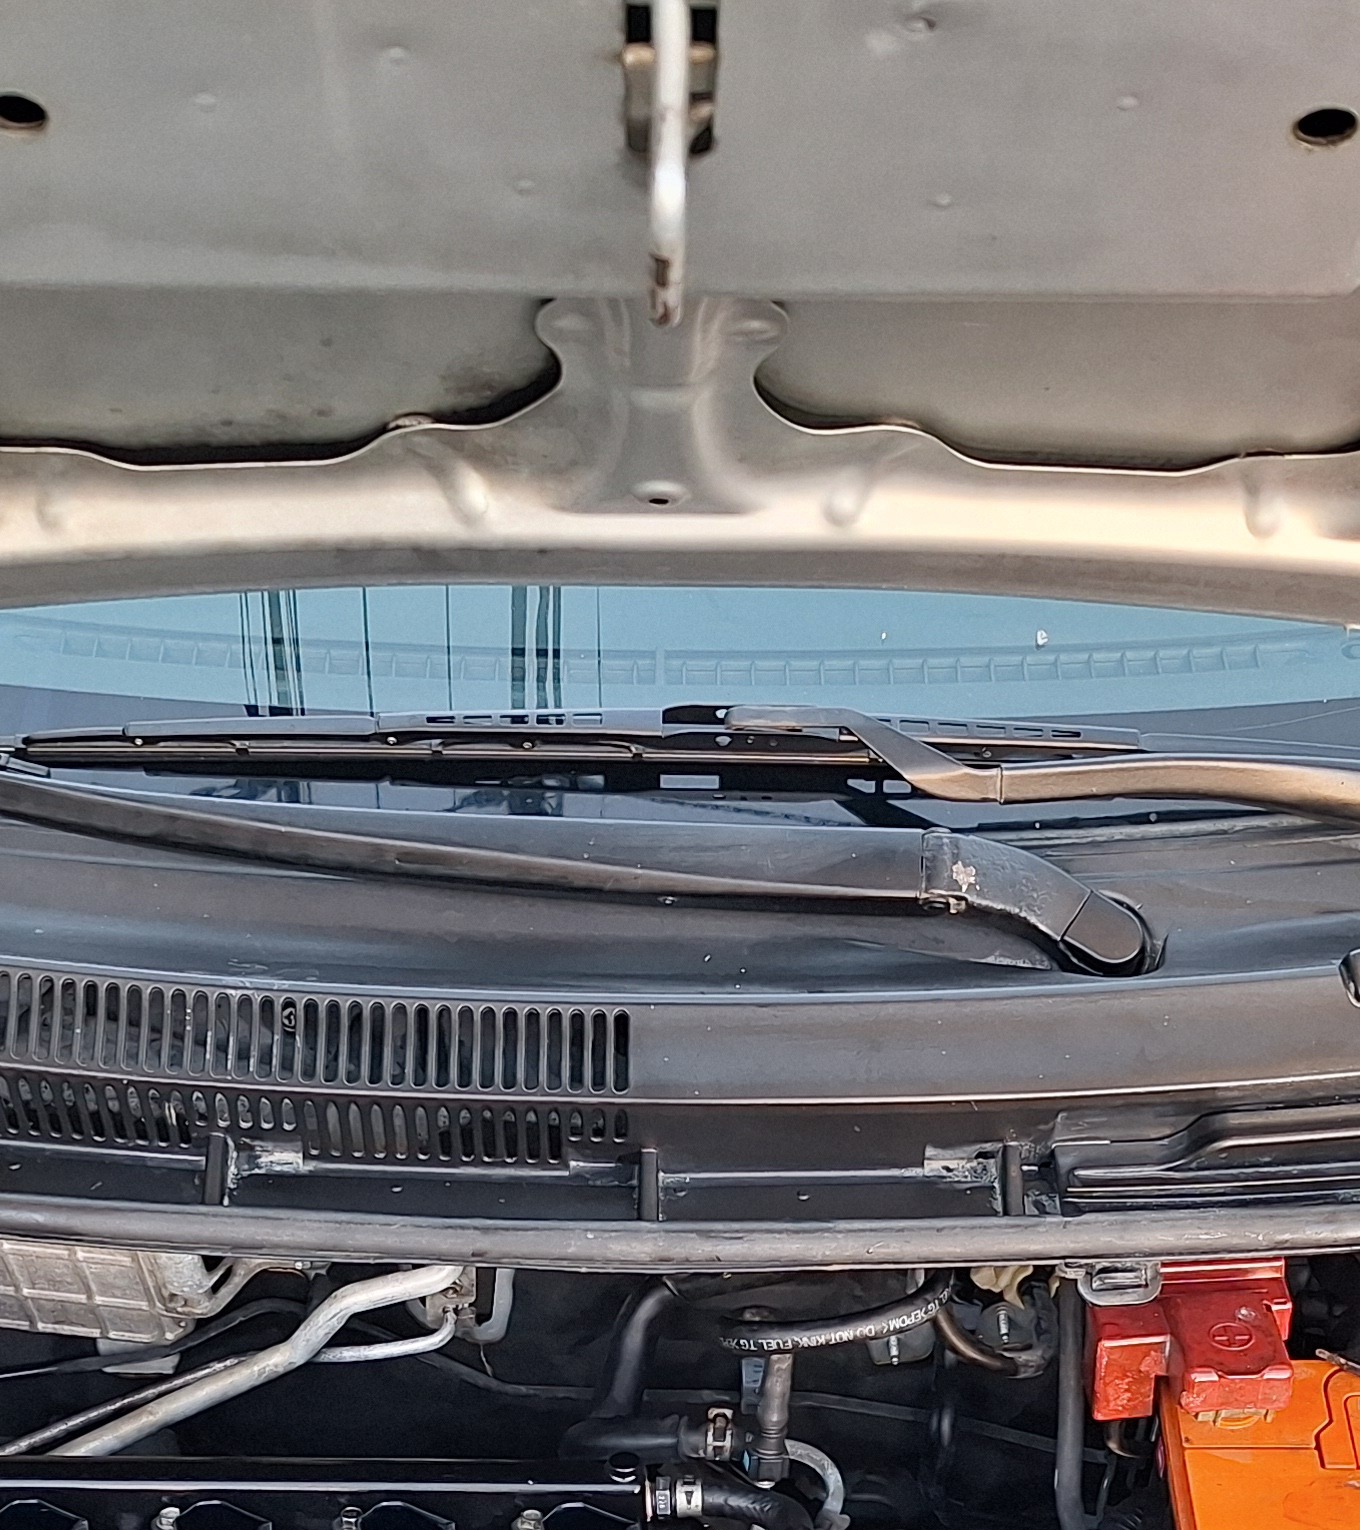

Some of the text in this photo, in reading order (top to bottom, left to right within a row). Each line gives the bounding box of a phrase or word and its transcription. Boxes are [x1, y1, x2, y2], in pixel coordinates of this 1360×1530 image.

[828, 1329, 854, 1344] NOT
[856, 1325, 876, 1338] DO
[758, 1338, 793, 1351] FUEL
